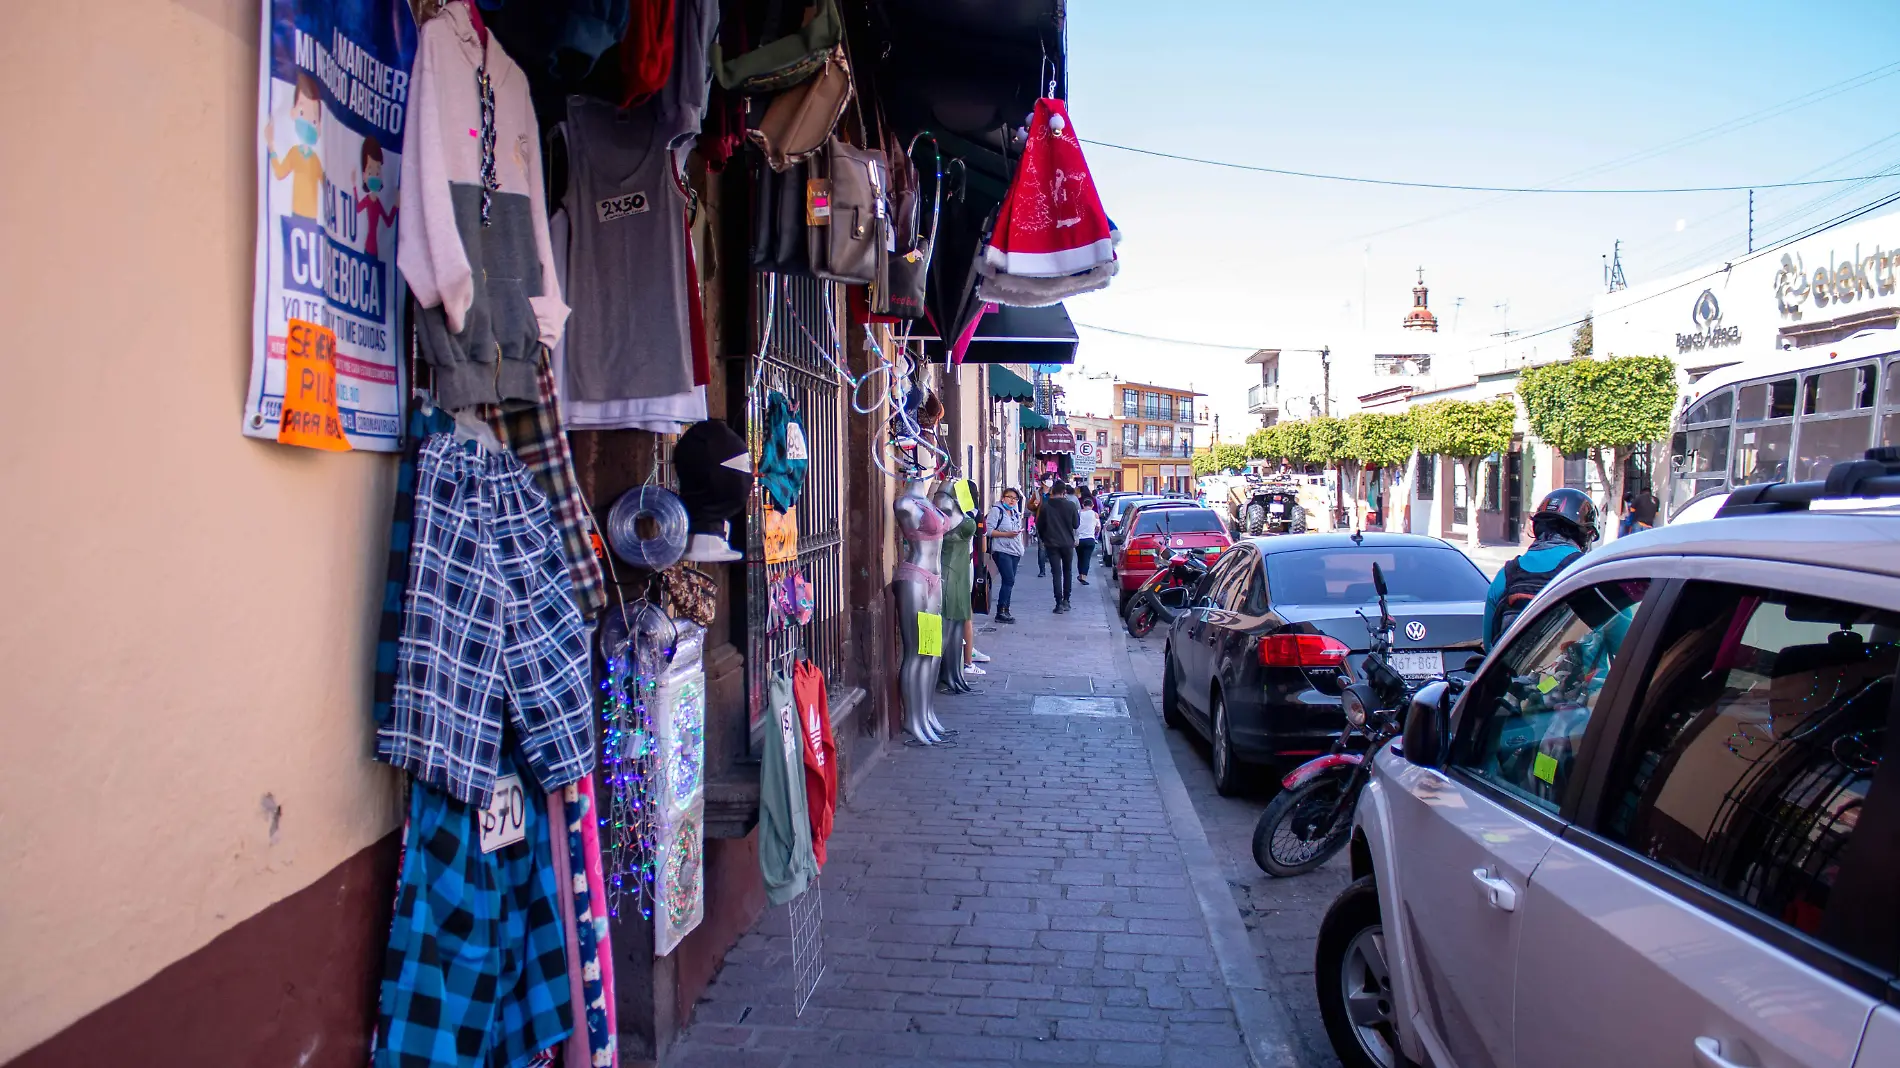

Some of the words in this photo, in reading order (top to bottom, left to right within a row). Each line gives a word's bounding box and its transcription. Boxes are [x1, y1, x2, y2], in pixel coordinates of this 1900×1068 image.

[295, 28, 314, 72] MI
[316, 41, 348, 106] NEGOCIO
[349, 79, 403, 134] ABIERTO
[338, 32, 409, 103] MANTENER
[341, 190, 357, 243] TU
[290, 227, 380, 317] CUREBOCA
[1812, 242, 1900, 300] elektr
[358, 323, 387, 352] CUIDAS
[1675, 332, 1703, 348] Banco
[1082, 444, 1091, 454] E
